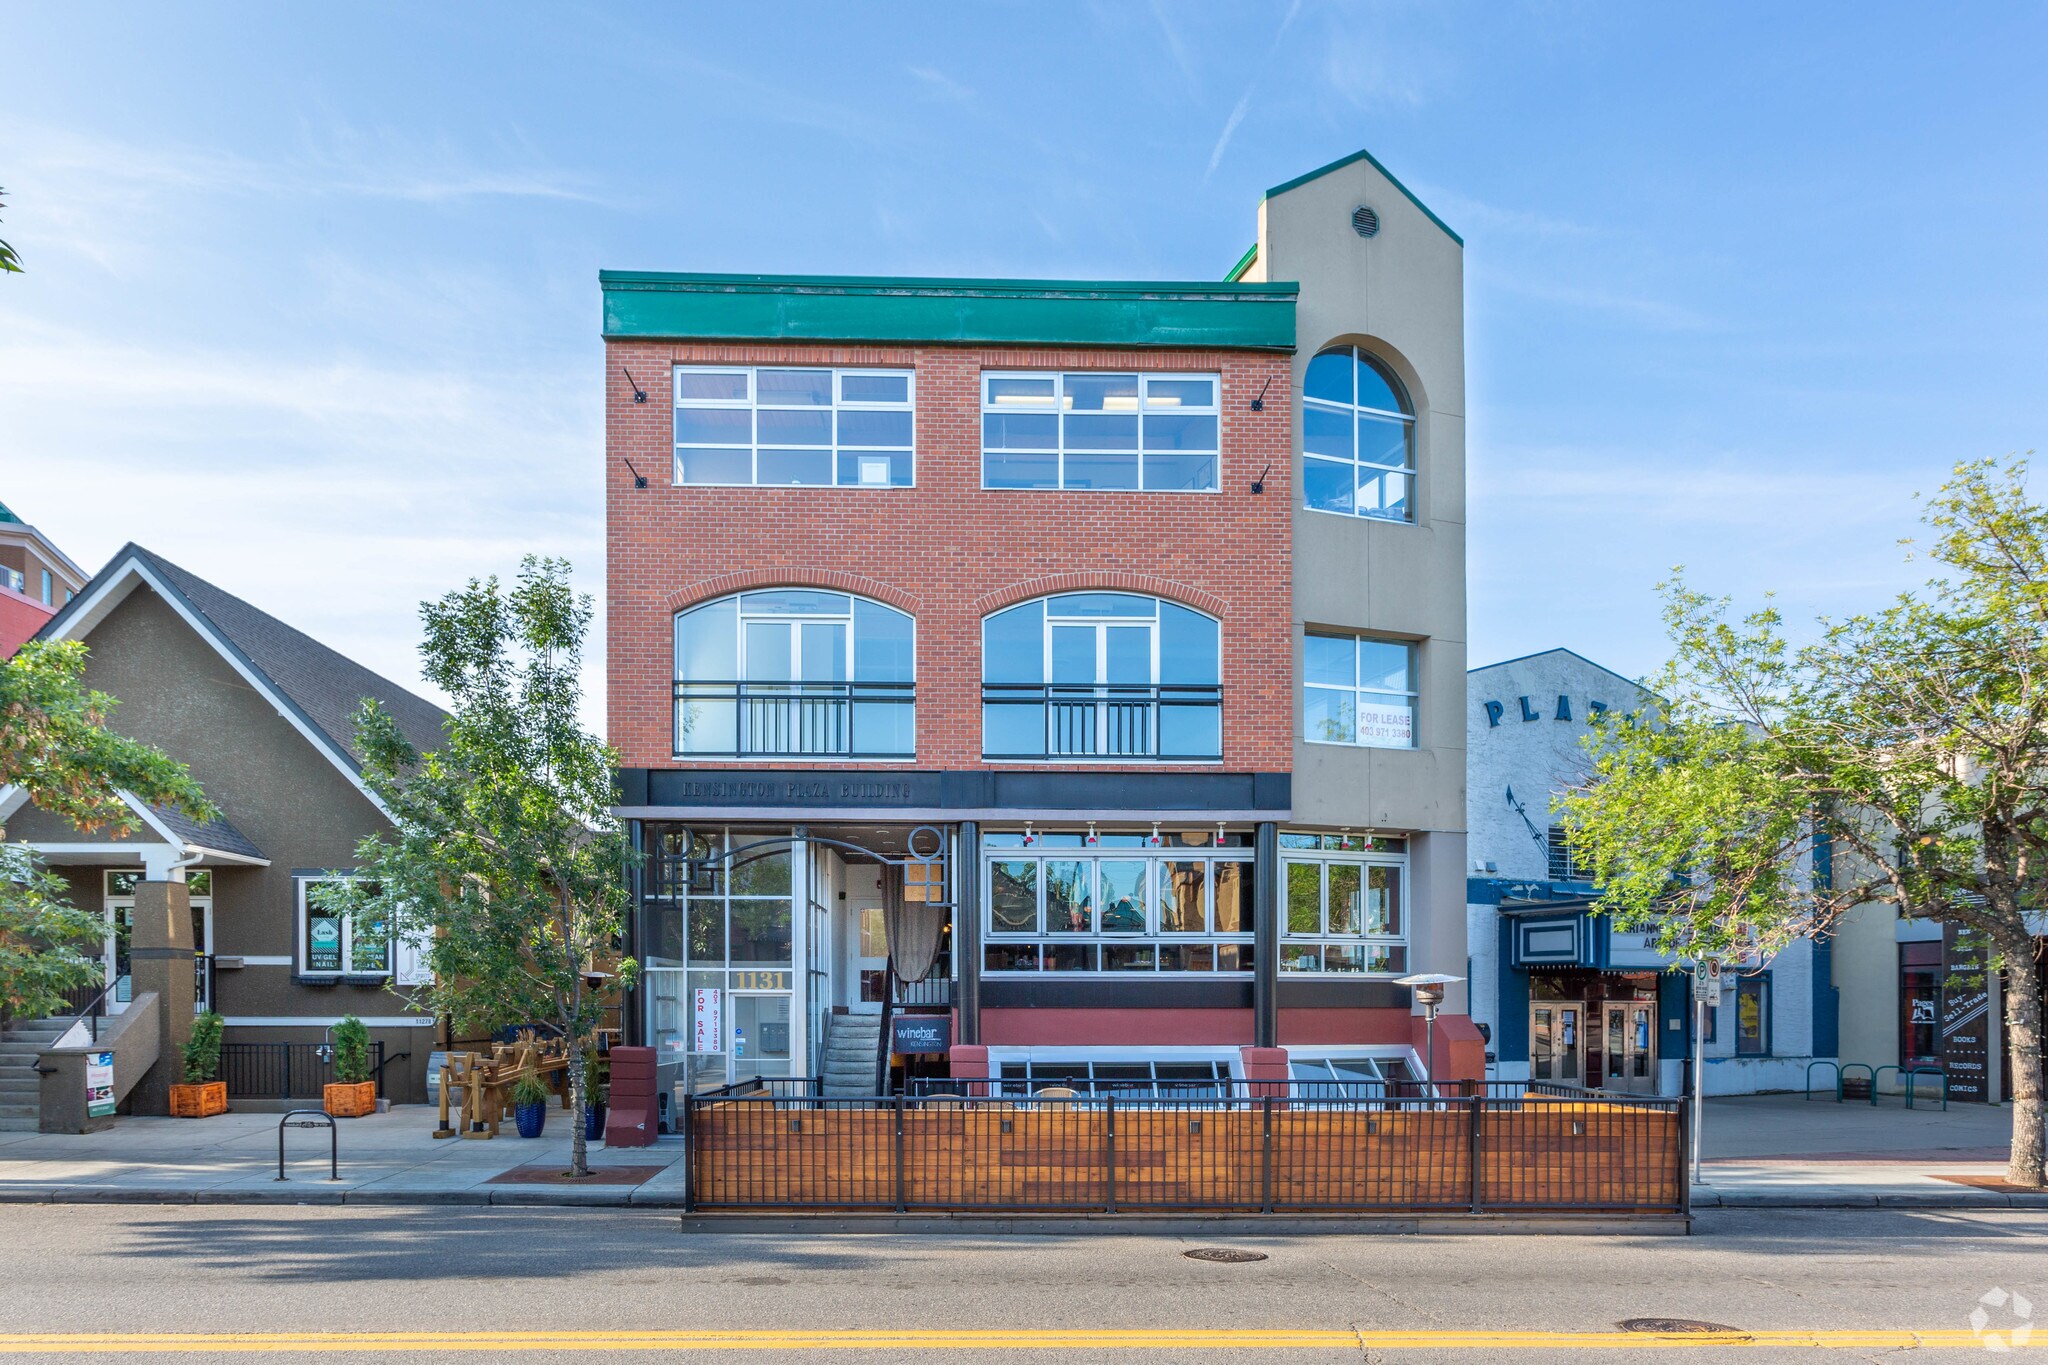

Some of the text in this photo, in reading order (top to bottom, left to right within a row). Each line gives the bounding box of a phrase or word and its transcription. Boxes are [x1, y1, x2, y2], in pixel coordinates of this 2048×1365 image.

[1360, 712, 1411, 726] FOR LEASE
[1360, 725, 1411, 738] 403 971 3380
[682, 782, 911, 798] KENSINGTON PLAZA BUILDING
[737, 971, 785, 990] 1131
[1911, 998, 1934, 1008] Pages
[1947, 993, 1967, 1006] Buy-
[1943, 991, 1988, 1022] Sell-Trade
[697, 989, 705, 1051] FOR SALE
[896, 1026, 938, 1039] winebar
[1948, 1062, 1983, 1070] RECORDS
[1949, 1084, 1978, 1093] COMICS
